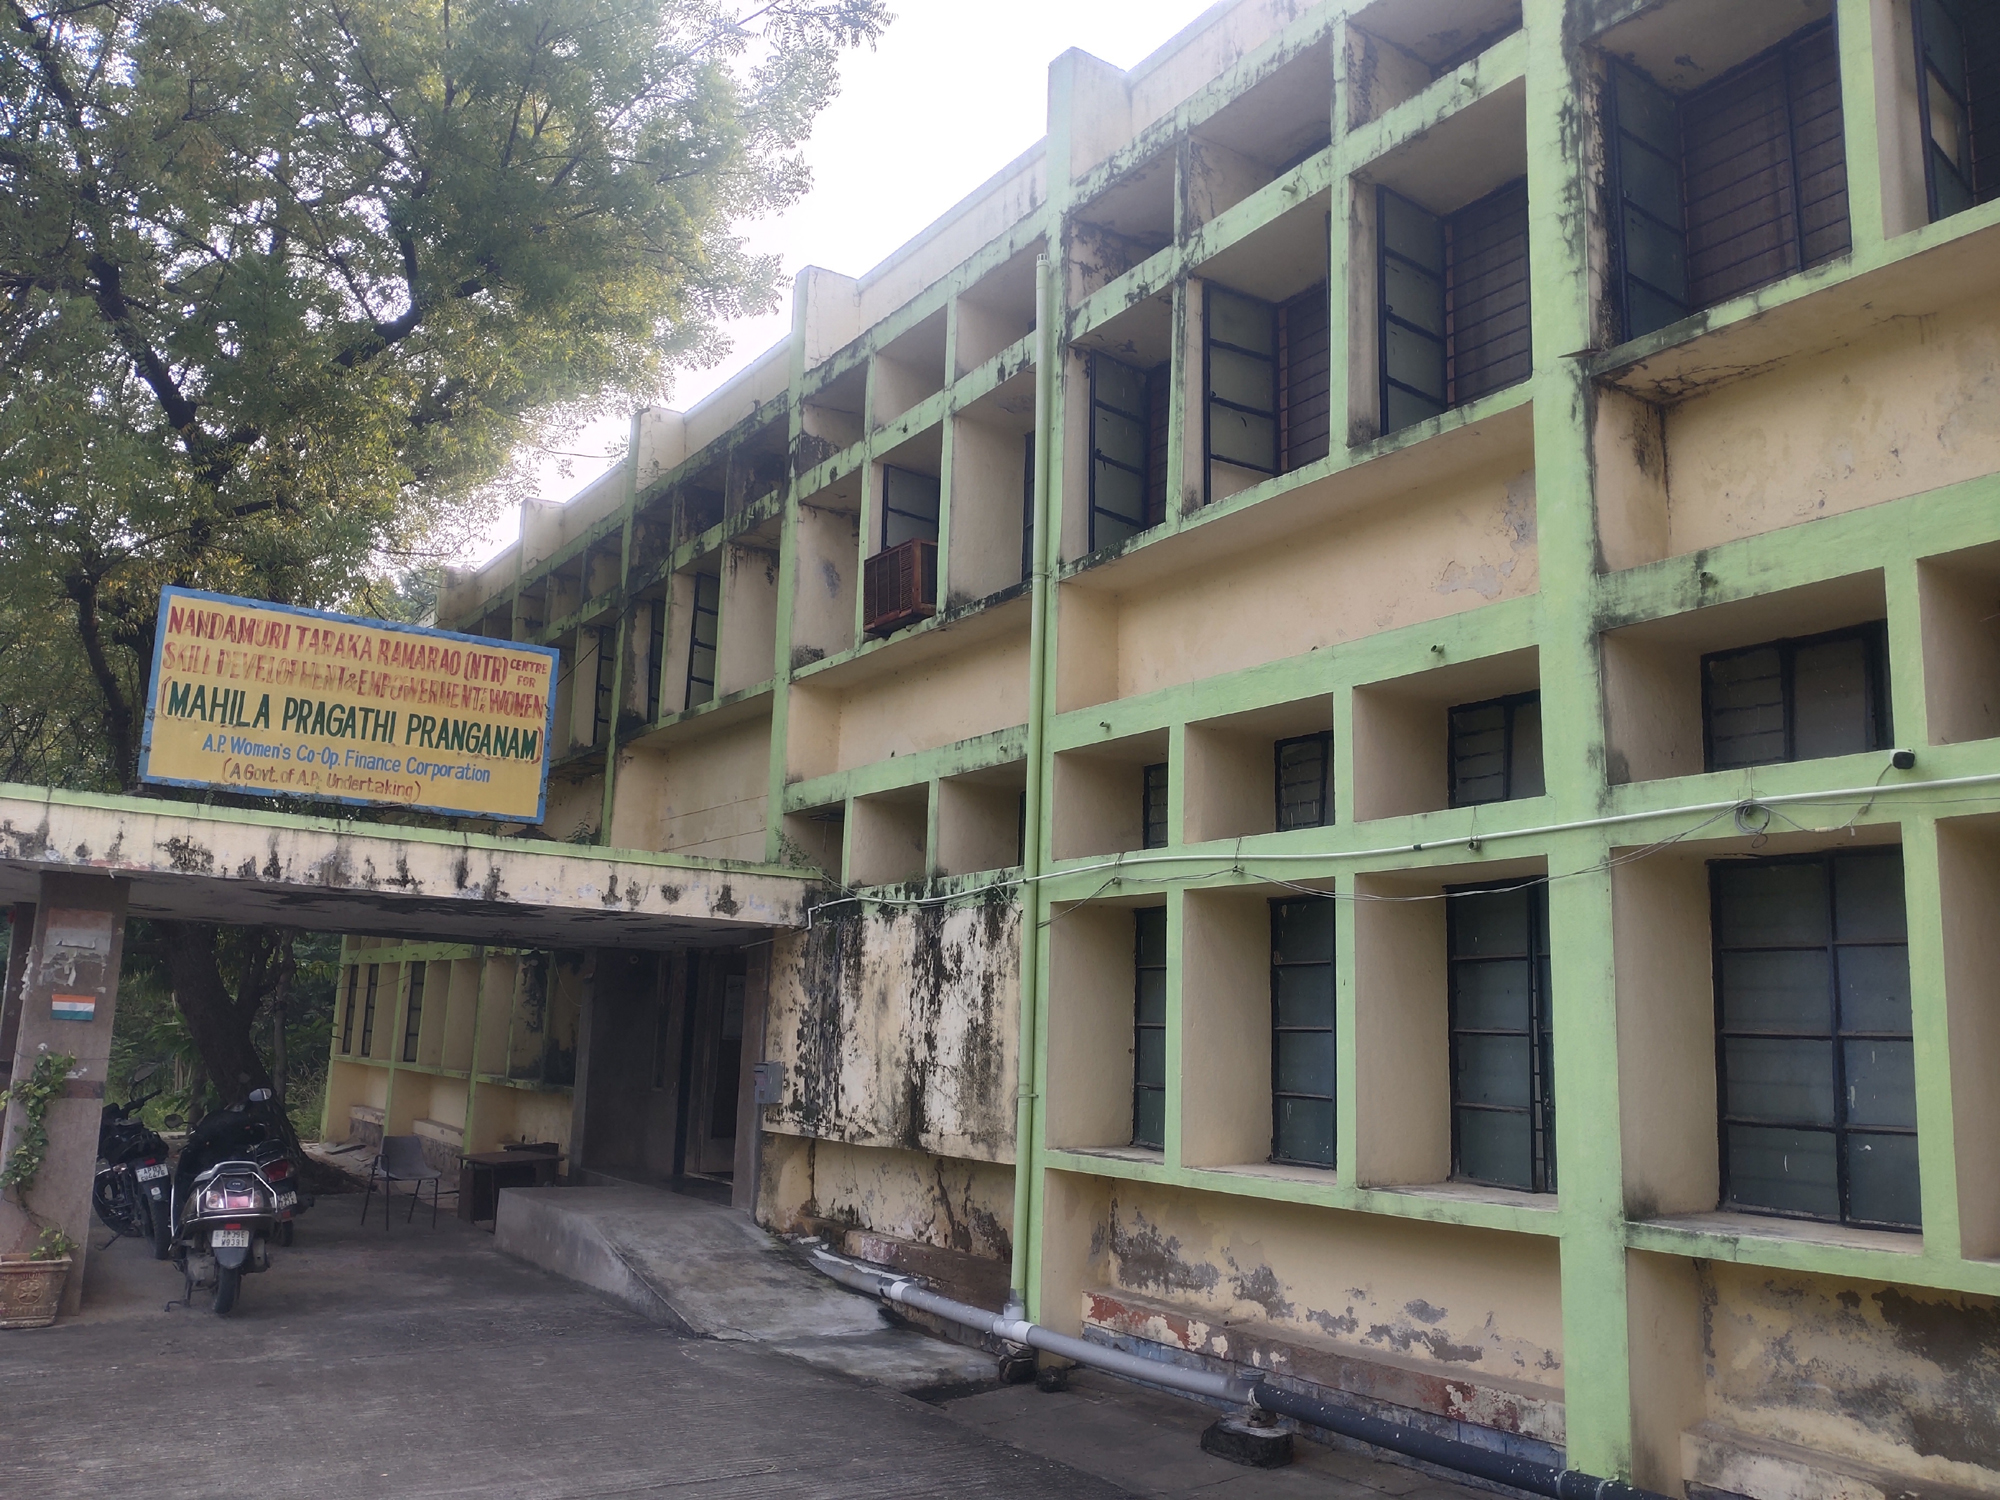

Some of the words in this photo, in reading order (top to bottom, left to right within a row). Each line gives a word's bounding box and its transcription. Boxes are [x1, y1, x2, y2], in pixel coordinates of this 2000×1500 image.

[168, 606, 291, 650] NANDAMURI
[296, 625, 372, 662] TARAKA
[376, 638, 461, 677] RAMARAO
[463, 651, 508, 686] (NTR)
[510, 658, 548, 675] CENTRE
[162, 641, 211, 675] SKILL
[489, 688, 545, 720] WOMEN
[516, 675, 536, 688] FOR
[281, 697, 397, 744] PRAGATHI
[405, 713, 544, 765] PRANGANAM)
[202, 733, 226, 753] A.P.
[230, 736, 291, 760] Women's
[296, 744, 341, 770] Co-Op.
[345, 749, 401, 772] Finance
[406, 757, 490, 783] Corporation
[243, 763, 278, 783] Govt.
[281, 768, 295, 783] of
[327, 773, 422, 803] Undertaking)
